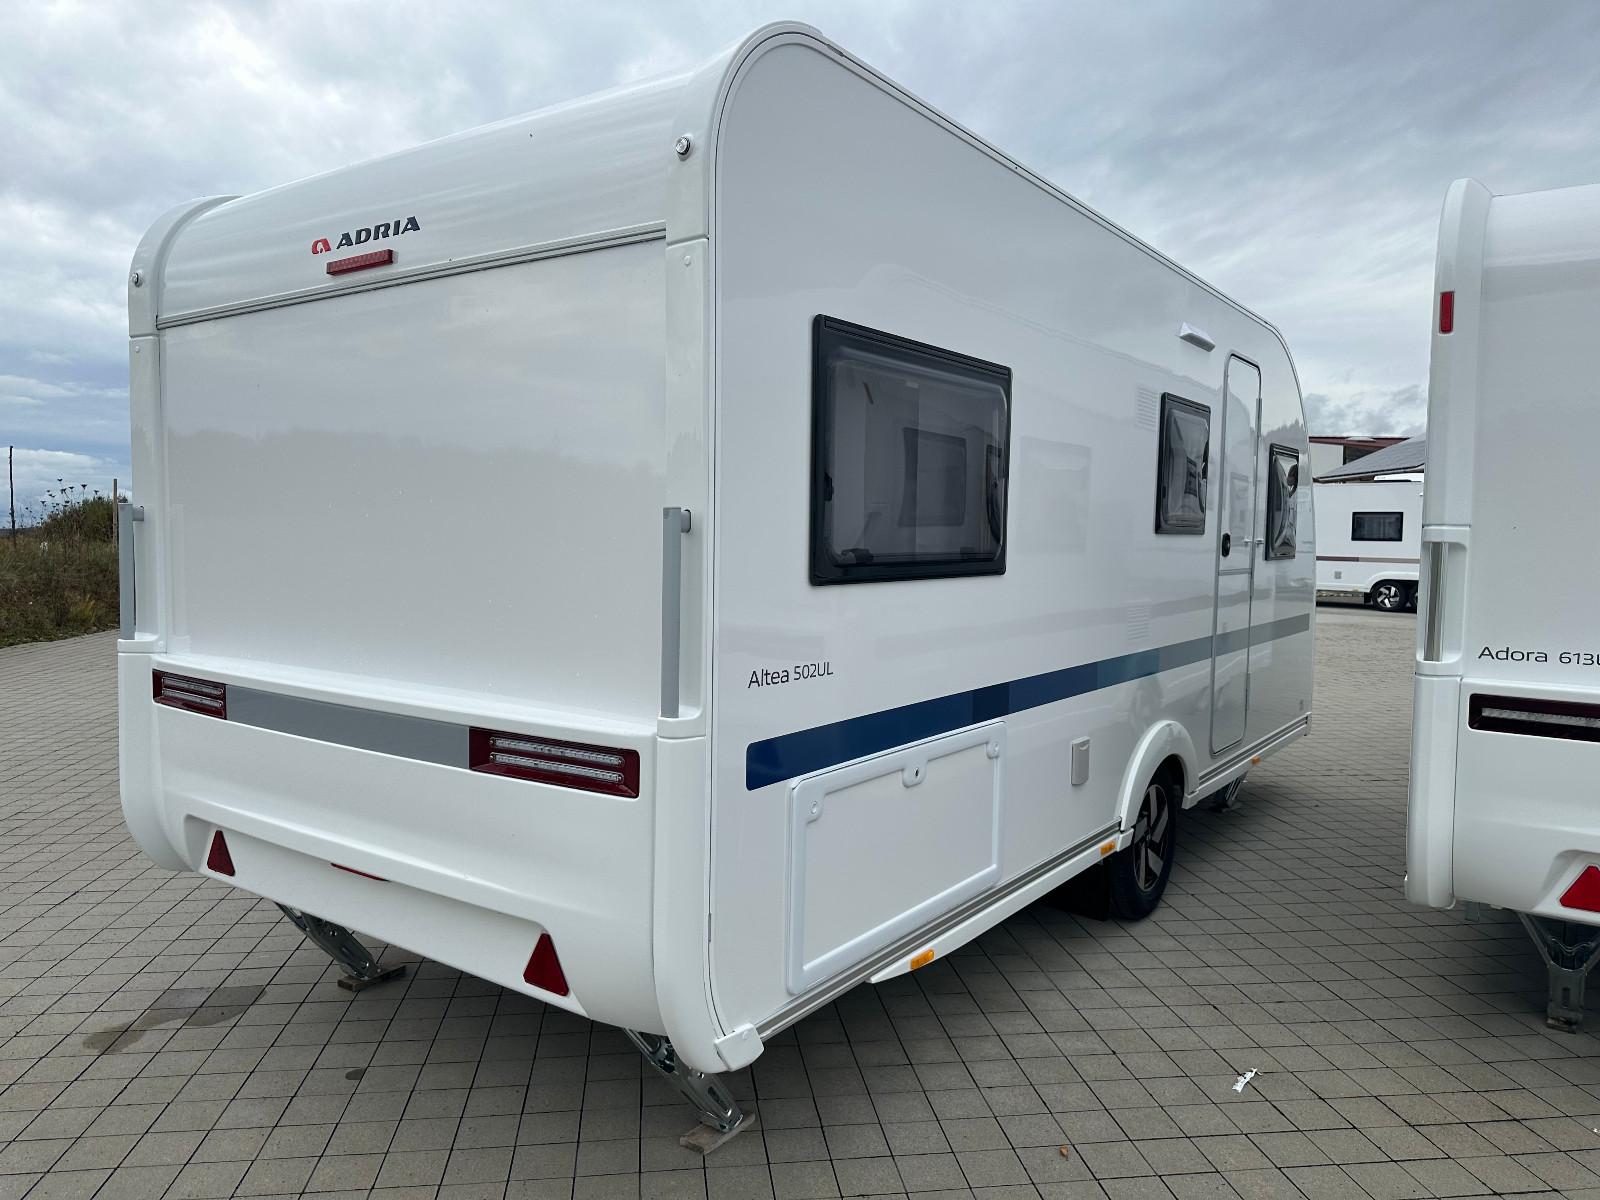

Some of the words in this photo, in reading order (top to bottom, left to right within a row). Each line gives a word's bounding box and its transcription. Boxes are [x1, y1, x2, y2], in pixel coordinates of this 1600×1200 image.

[336, 216, 420, 249] ADRIA
[1478, 646, 1548, 663] Adora
[747, 668, 789, 689] Altea
[793, 661, 834, 681] 502UL
